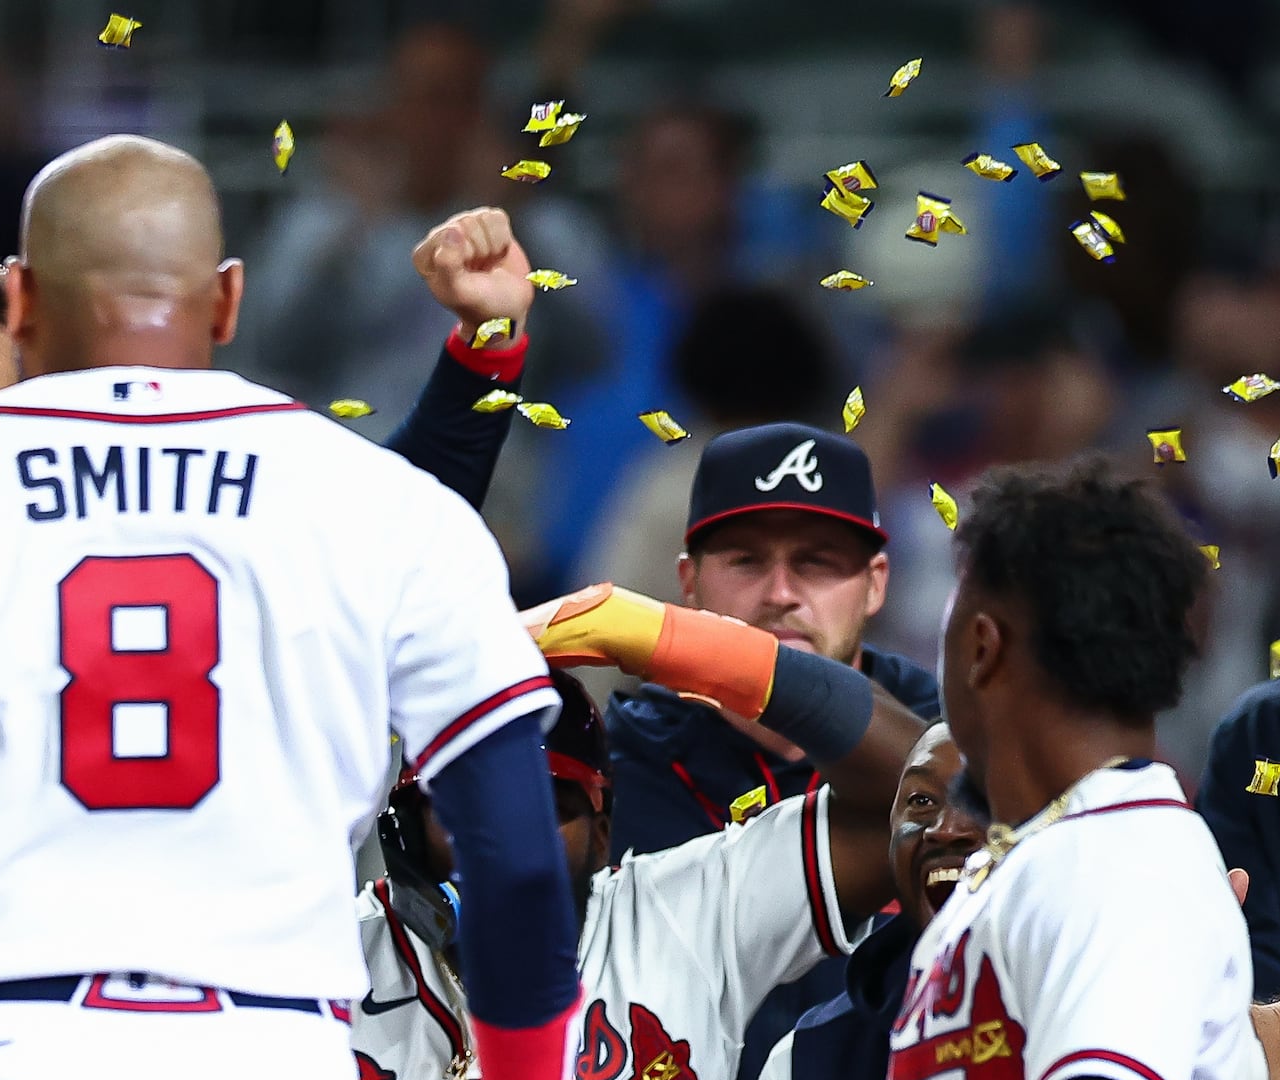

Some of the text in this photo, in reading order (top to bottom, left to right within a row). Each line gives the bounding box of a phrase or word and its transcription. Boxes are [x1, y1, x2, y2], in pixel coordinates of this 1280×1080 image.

[16, 445, 258, 522] SMITH
[755, 438, 823, 492] A
[58, 552, 221, 813] 8
